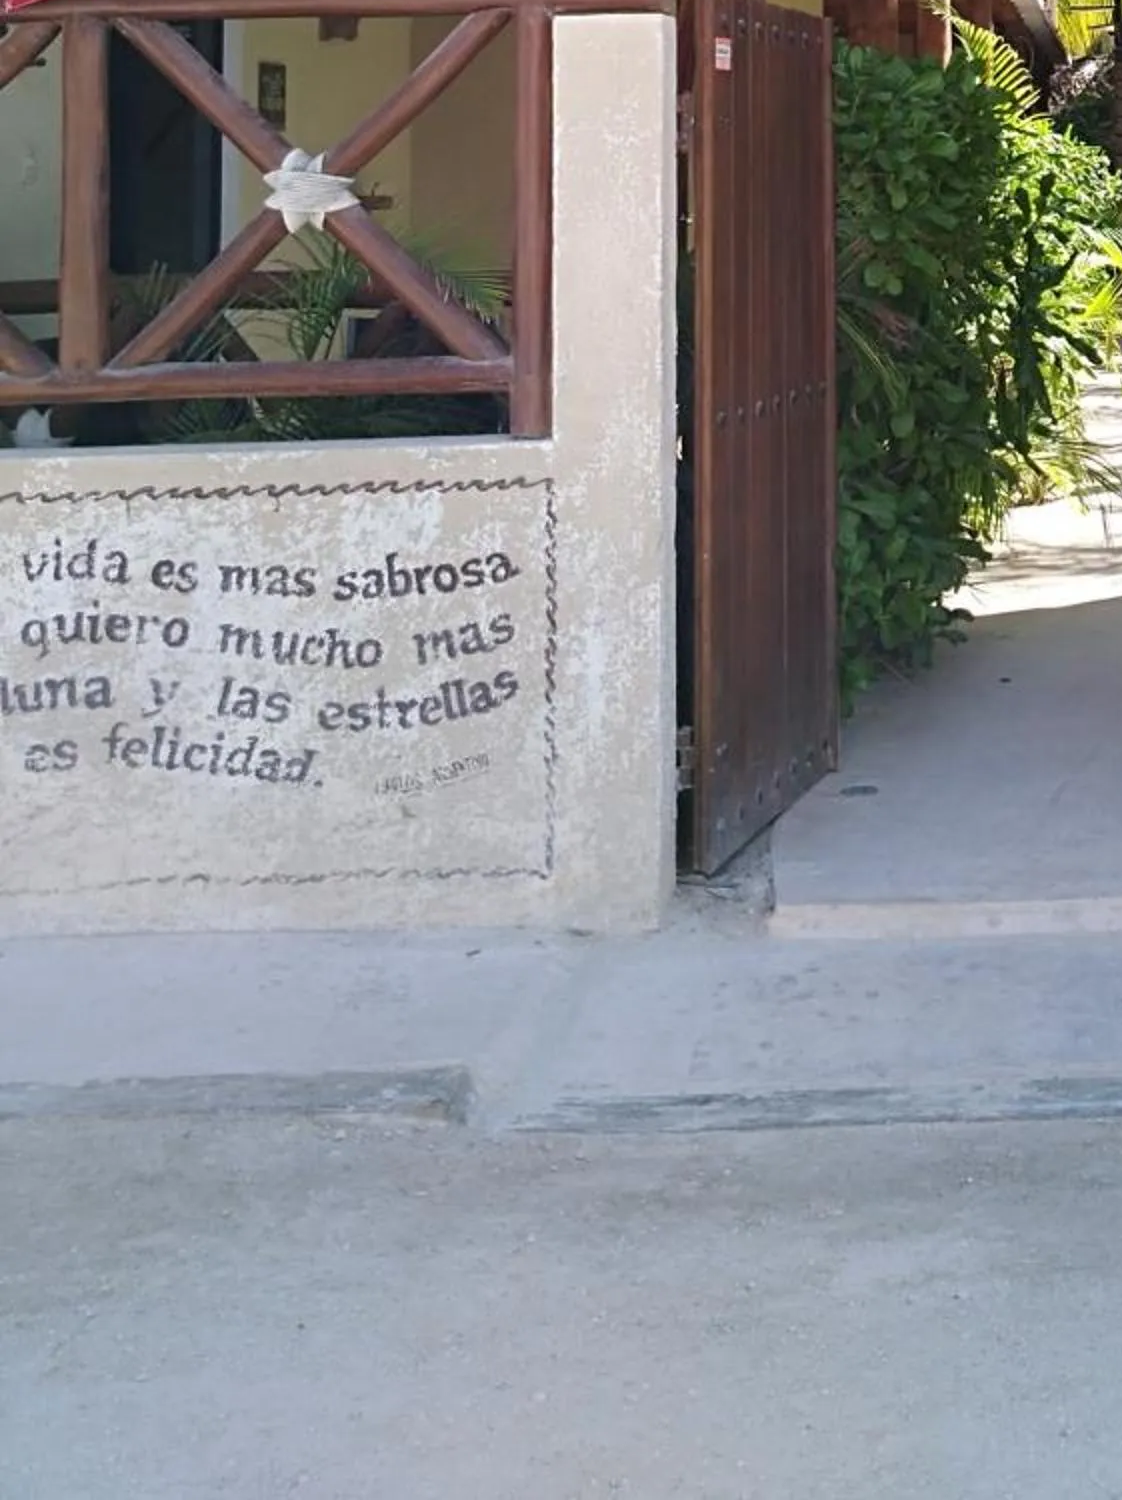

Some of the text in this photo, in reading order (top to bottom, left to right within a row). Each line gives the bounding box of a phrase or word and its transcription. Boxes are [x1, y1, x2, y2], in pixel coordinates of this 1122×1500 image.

[22, 536, 522, 601] vida es mas sabrosa
[20, 599, 516, 670] quiero mucho mas
[0, 669, 520, 732] luna y las estrellas
[100, 721, 324, 789] felicidad.
